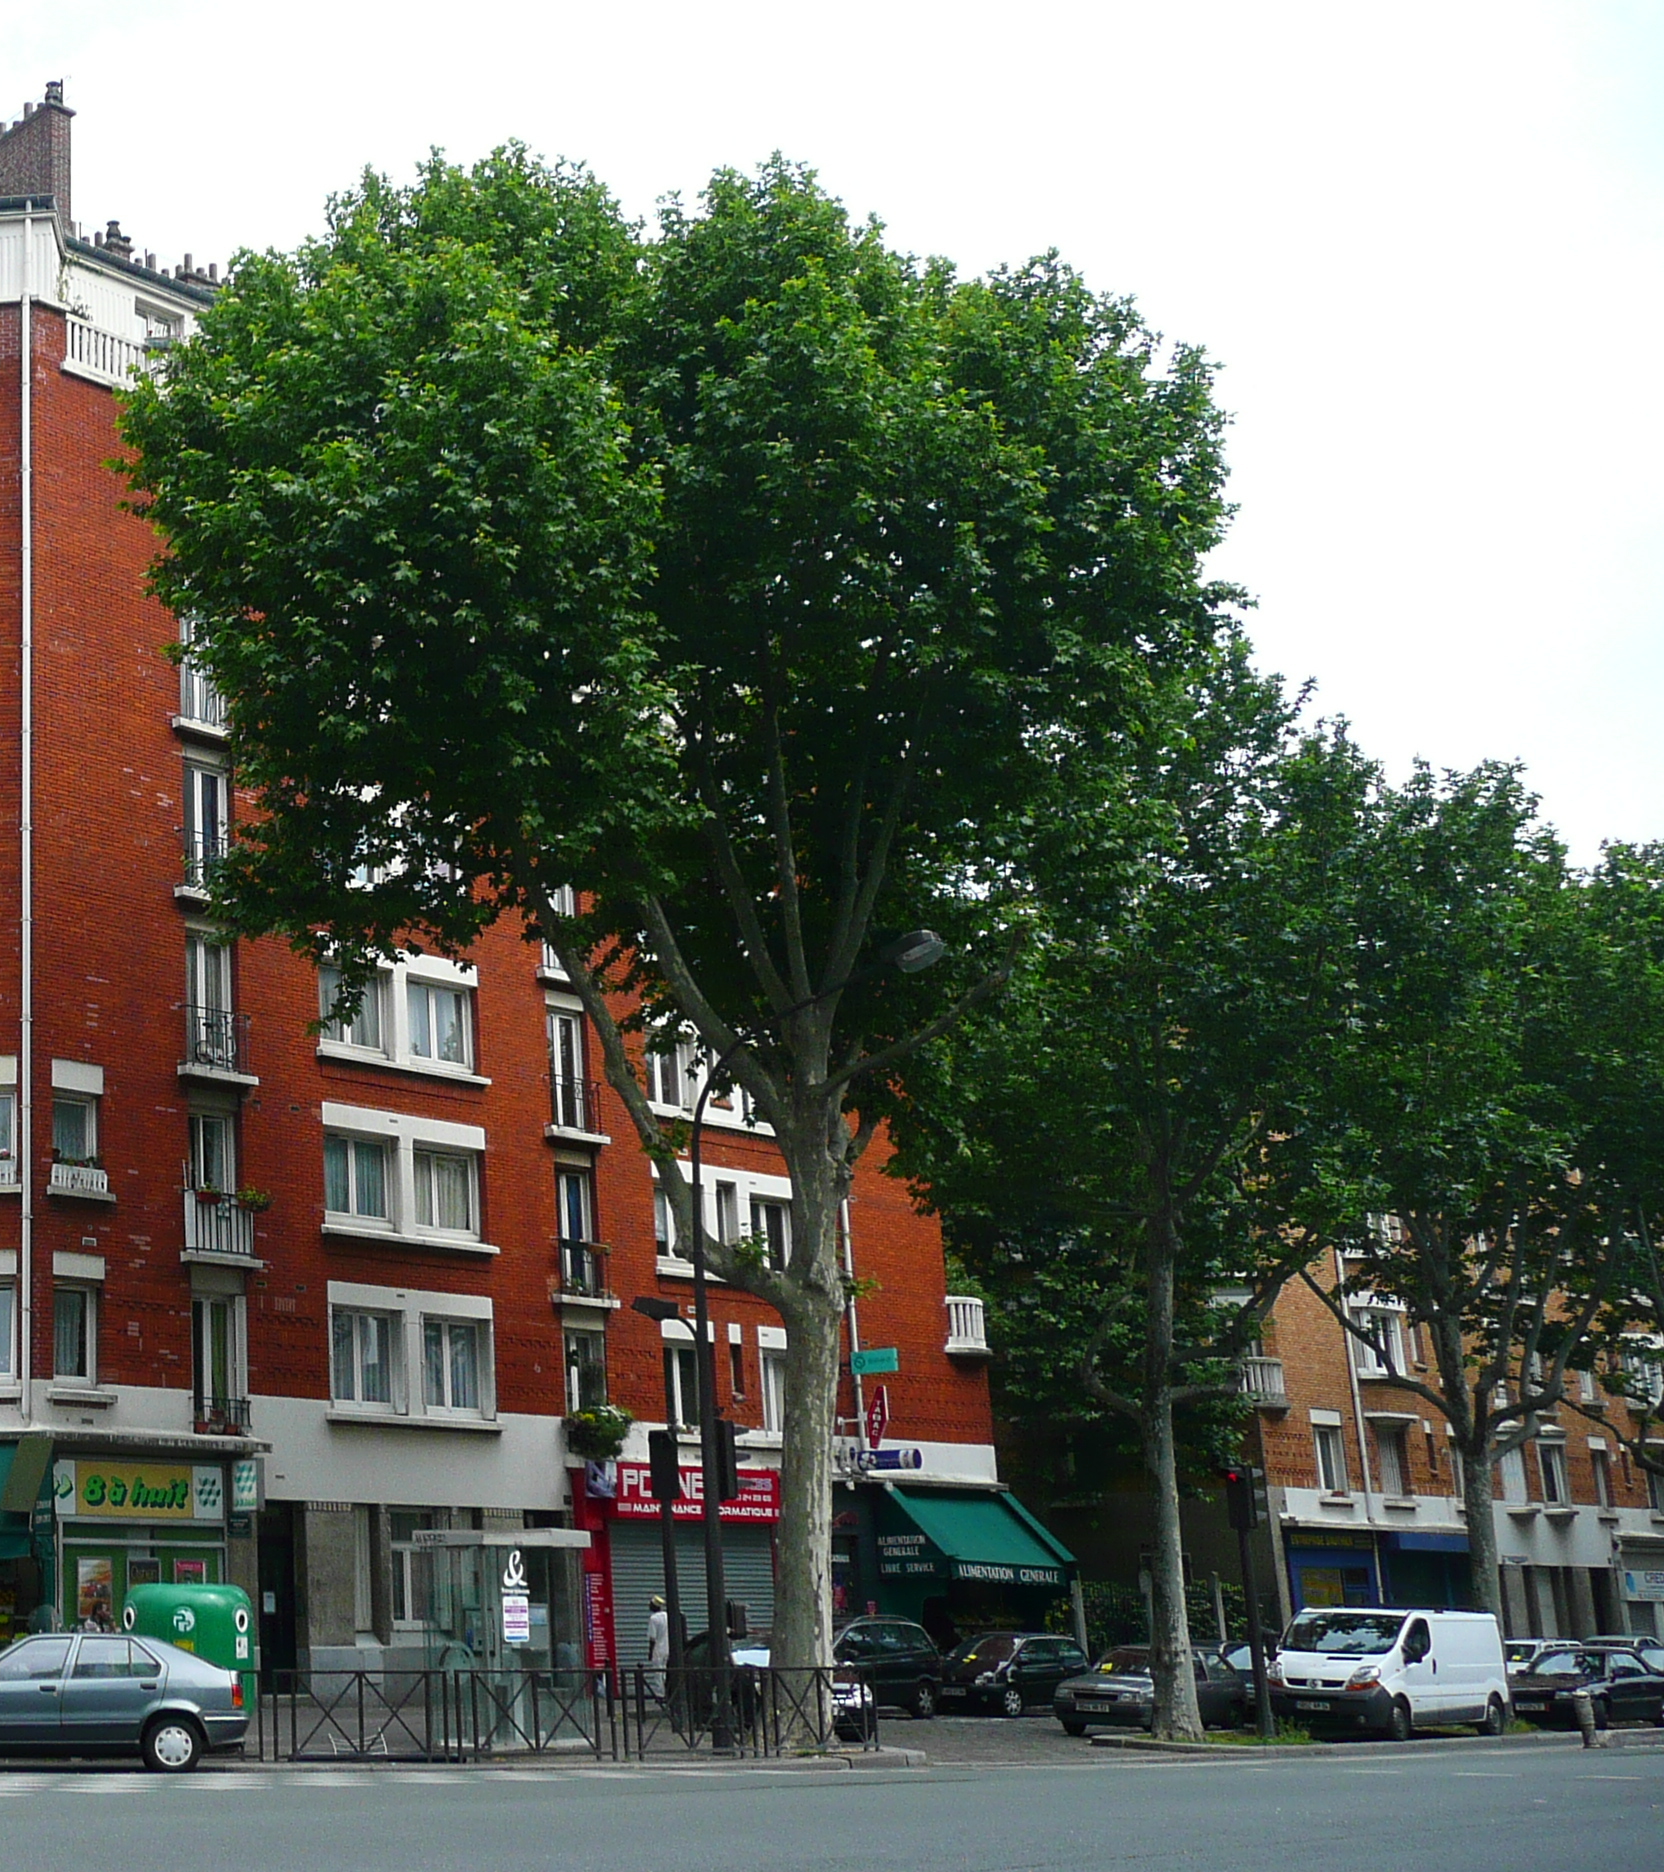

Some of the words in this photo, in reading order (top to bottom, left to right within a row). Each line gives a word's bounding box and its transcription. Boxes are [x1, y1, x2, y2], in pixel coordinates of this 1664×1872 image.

[872, 1400, 882, 1436] TABAC
[83, 1474, 106, 1507] 8
[108, 1476, 127, 1507] à
[130, 1476, 189, 1510] huit
[633, 1502, 702, 1515] MAINNANCE
[718, 1505, 773, 1517] ORMATIQUE
[877, 1534, 926, 1546] ALIMENTATION
[906, 1562, 935, 1573] SERVICE
[958, 1563, 1014, 1580] ALIMENTATION
[1020, 1568, 1059, 1583] GENERALE
